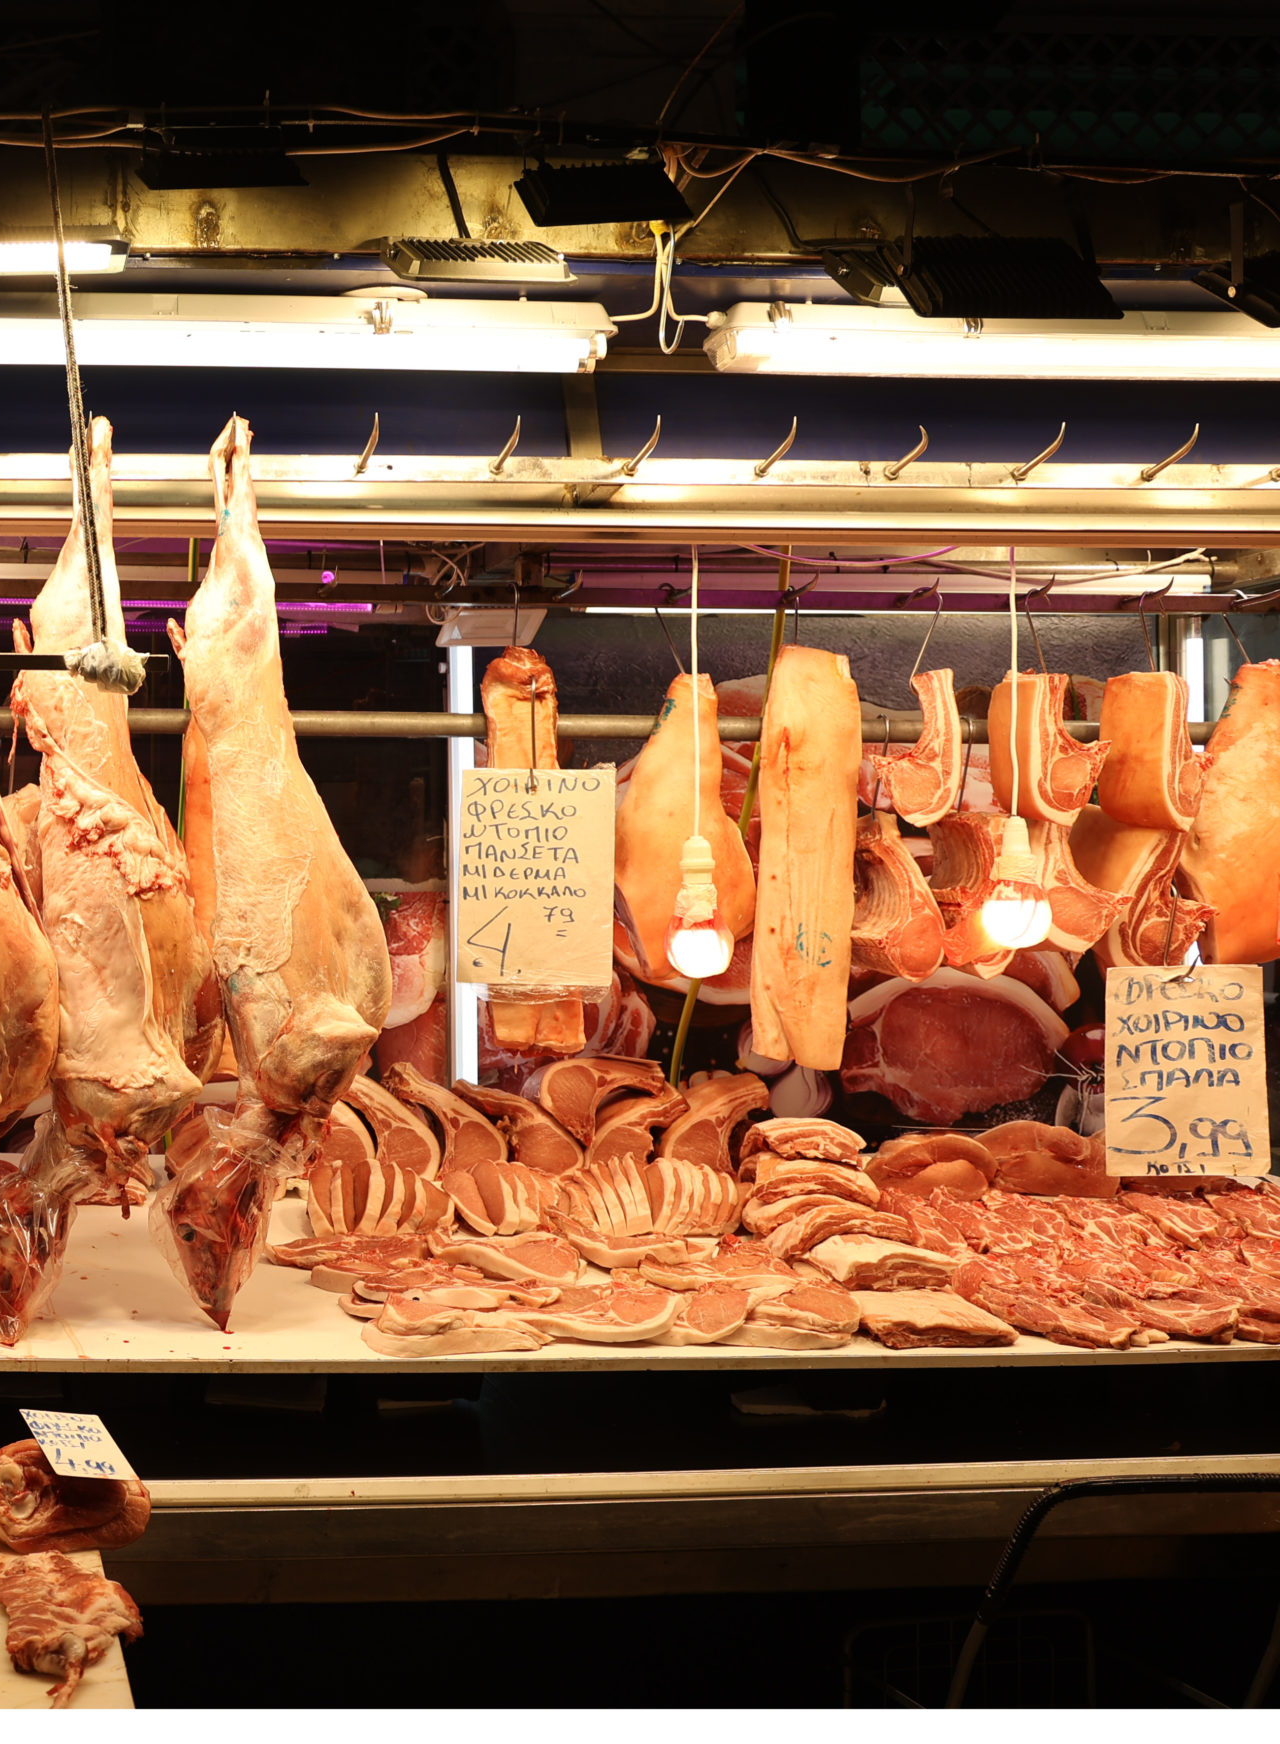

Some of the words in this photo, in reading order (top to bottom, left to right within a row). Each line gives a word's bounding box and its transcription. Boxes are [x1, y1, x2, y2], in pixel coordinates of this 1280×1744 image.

[467, 799, 577, 822] ΦΡΕΣΚΟ
[463, 822, 568, 843] ΝΤΟΠΙΟ
[465, 841, 579, 864] ΠΑΝΣΕΤΑ
[1116, 1037, 1254, 1068] ΝΤΟΠΙΟ
[1107, 1096, 1254, 1160] 3,99
